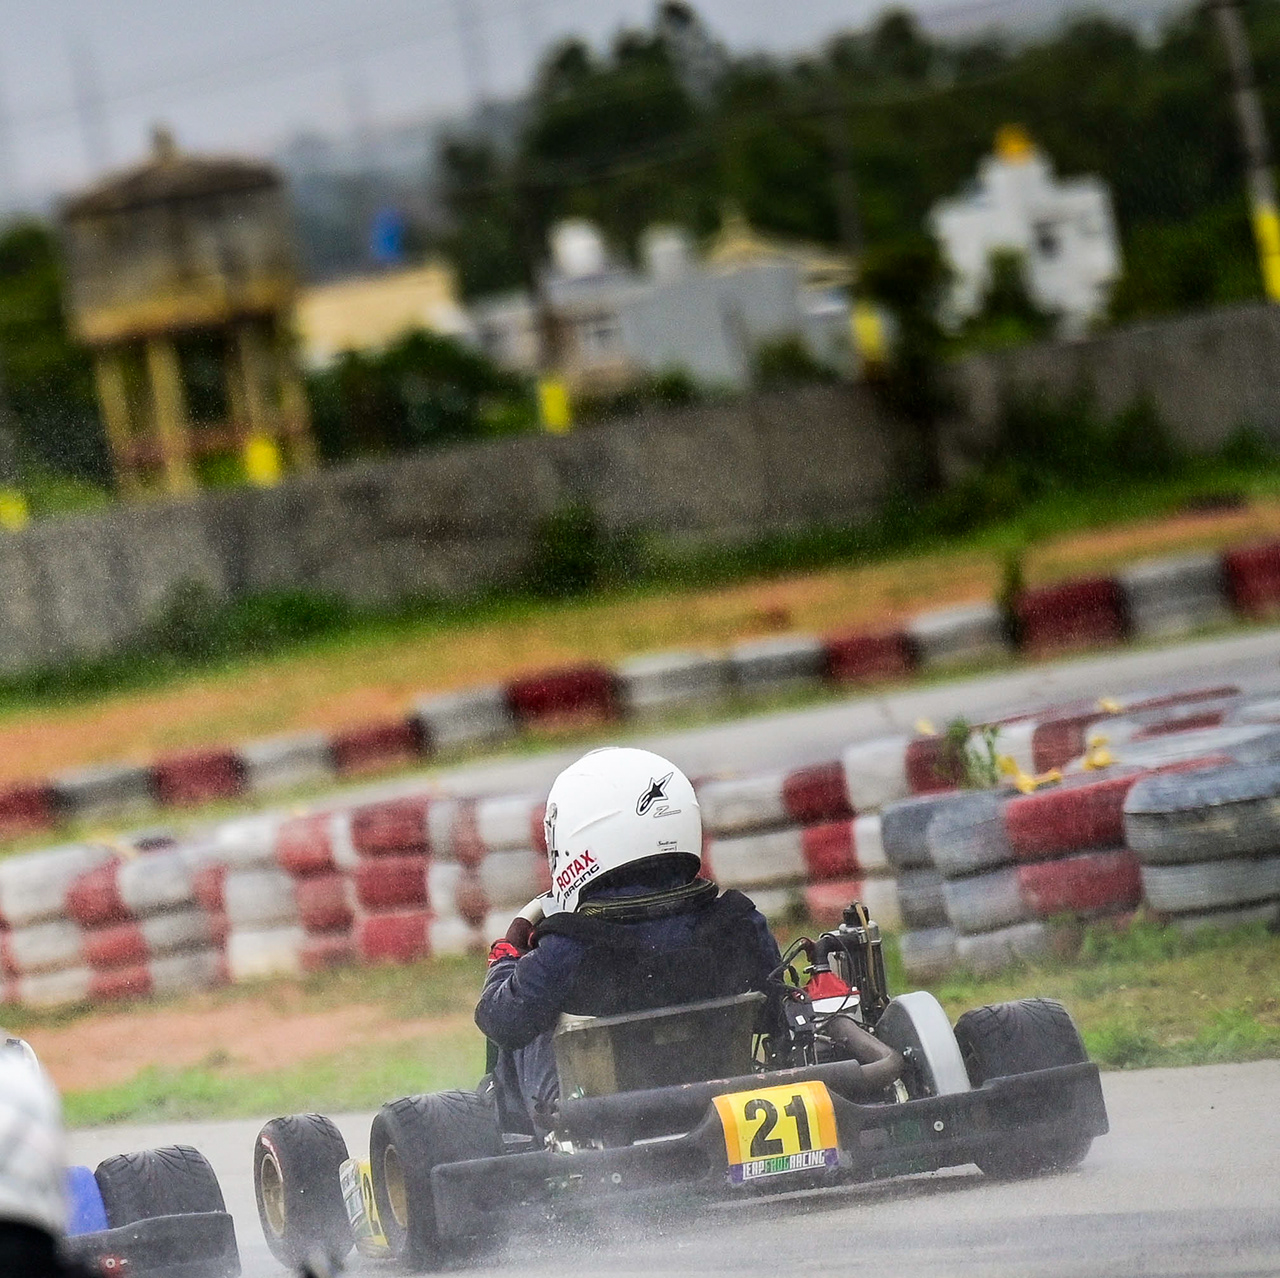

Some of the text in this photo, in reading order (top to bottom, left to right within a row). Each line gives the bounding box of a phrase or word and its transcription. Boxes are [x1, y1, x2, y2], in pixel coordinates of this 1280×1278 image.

[556, 850, 595, 891] ROTAX
[564, 864, 600, 899] RACING
[744, 1095, 812, 1157] 21
